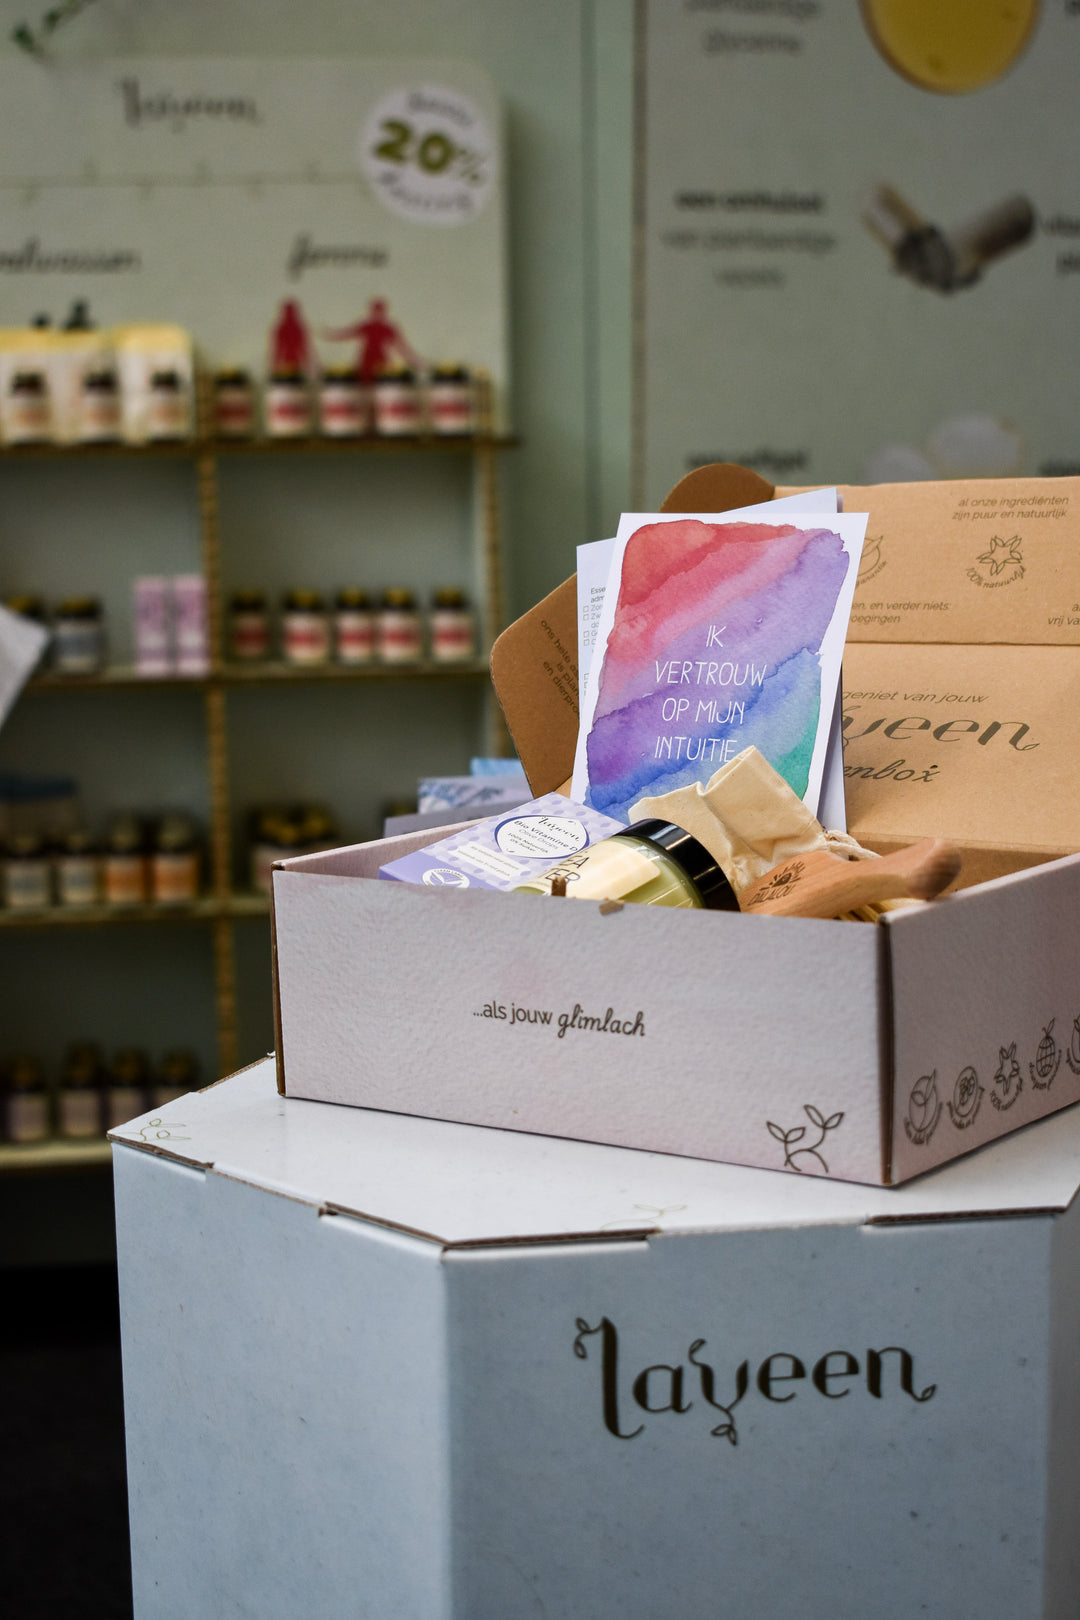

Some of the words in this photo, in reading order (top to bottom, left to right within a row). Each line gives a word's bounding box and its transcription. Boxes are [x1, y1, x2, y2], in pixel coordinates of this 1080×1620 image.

[971, 498, 998, 507] onze
[1000, 496, 1070, 509] ingrediënten
[952, 510, 970, 521] zijn
[971, 511, 999, 521] puur
[1000, 510, 1015, 519] en
[1016, 508, 1068, 520] natuurlijk
[870, 602, 884, 610] en
[886, 601, 922, 611] verder
[1047, 615, 1065, 627] vrij
[705, 624, 727, 648] IK
[543, 661, 555, 677] en
[654, 660, 768, 688] VERTROUW
[902, 691, 936, 703] van
[934, 692, 990, 704] jouw
[661, 696, 691, 722] OP
[694, 699, 746, 725] MIJN
[653, 735, 738, 763] INTUITIE
[513, 820, 530, 830] Bio
[530, 827, 570, 849] Vitamine
[509, 1002, 553, 1025] jouw
[557, 1003, 646, 1039] glimlach
